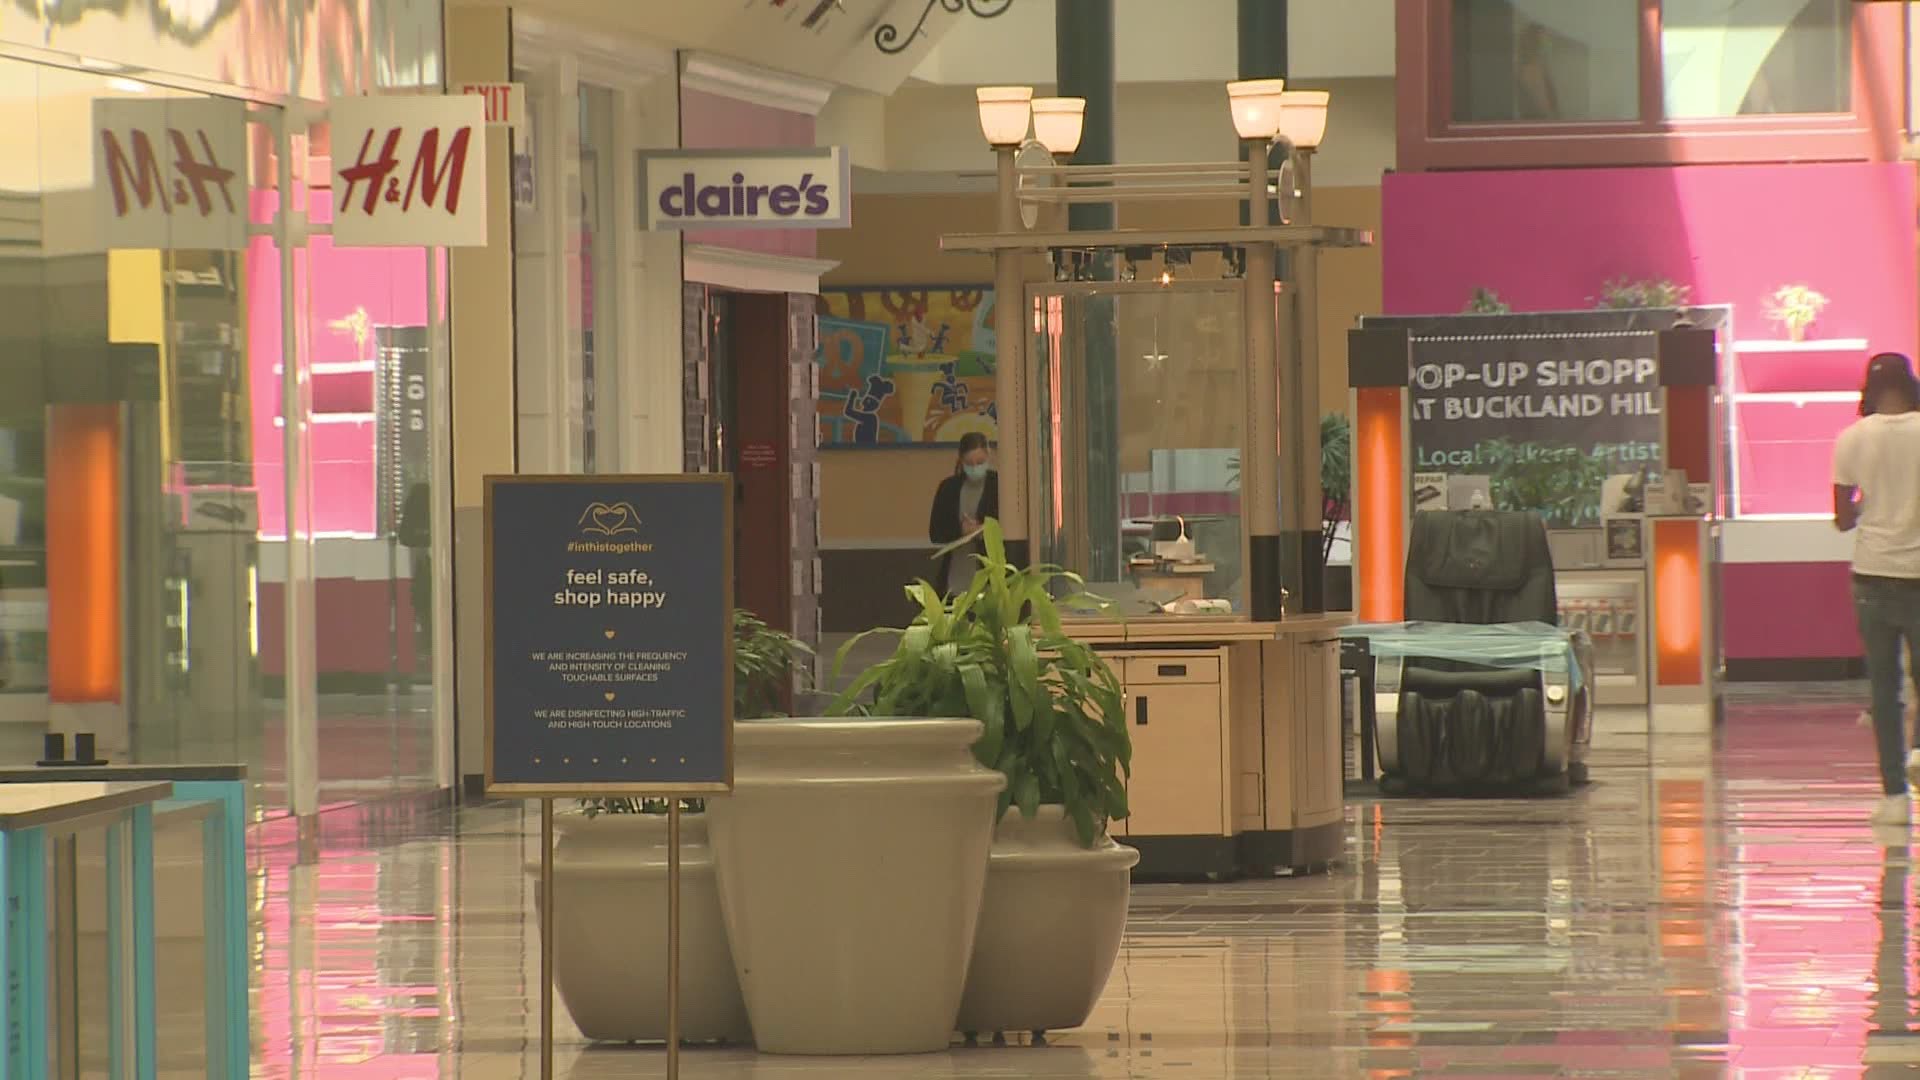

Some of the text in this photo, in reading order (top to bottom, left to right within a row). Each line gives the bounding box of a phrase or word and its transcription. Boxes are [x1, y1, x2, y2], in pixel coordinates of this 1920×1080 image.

[463, 85, 512, 122] XIT
[338, 126, 472, 216] H&M
[659, 172, 830, 217] claire's
[1410, 357, 1657, 389] OP-UP SHOPP
[1444, 394, 1605, 420] BUCKLAND
[1611, 391, 1663, 416] HIL
[1418, 443, 1483, 466] Local
[566, 540, 653, 554] #inthistogether
[566, 569, 653, 587] feel safe,
[554, 588, 666, 608] shop happy
[531, 651, 687, 661] WE ARE INCREASING THE FREQUENCY
[549, 662, 671, 672] AND INTENSITY OF CLEANING
[562, 673, 658, 683] TOUCHABLE SURFACES
[534, 709, 547, 719] WE
[550, 709, 566, 719] ARE
[568, 709, 626, 719] DISINFECTING
[548, 720, 567, 730] AND
[624, 720, 672, 730] LOCATIONS
